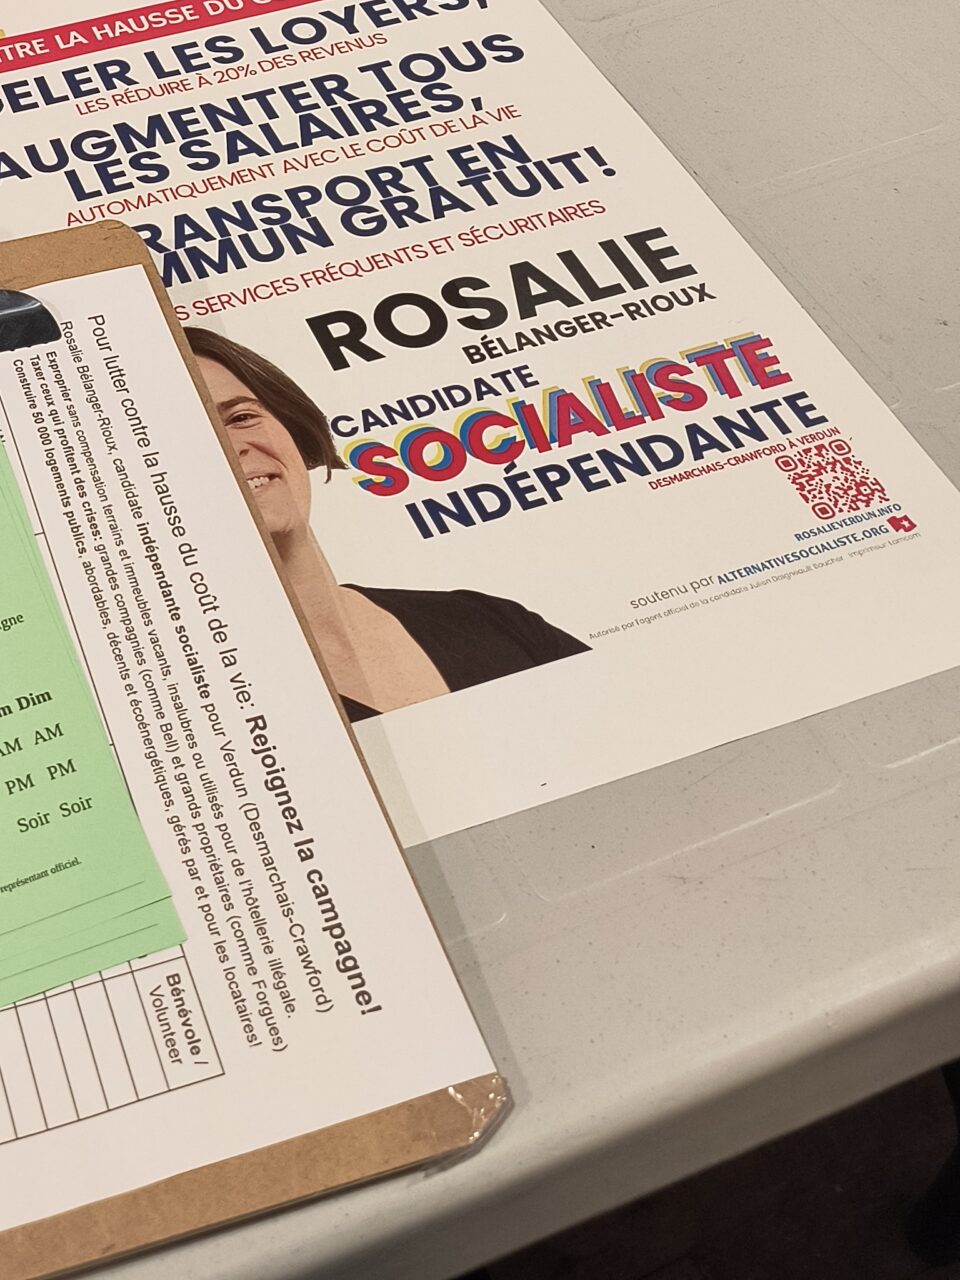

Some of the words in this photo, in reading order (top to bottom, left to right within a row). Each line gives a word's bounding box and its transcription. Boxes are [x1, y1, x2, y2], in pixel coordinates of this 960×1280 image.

[55, 31, 88, 49] LA
[92, 5, 199, 40] HAUSSE
[144, 36, 244, 79] LES
[76, 98, 109, 115] LES
[112, 78, 194, 106] RÉDUIRE
[199, 76, 212, 88] À
[213, 64, 257, 83] 20%
[257, 54, 297, 72] DES
[298, 33, 387, 62] REVENUS
[358, 34, 524, 92] TOUS
[64, 151, 170, 202] LES
[179, 82, 483, 171] SALAIRES,
[67, 162, 274, 226] AUTOMATIQUEMENT
[283, 149, 340, 174] AVEC
[345, 144, 366, 159] LE
[366, 126, 427, 152] COÛT
[429, 120, 459, 138] DE
[460, 113, 488, 130] LA
[486, 104, 521, 122] VIE
[138, 154, 439, 254] RANSPORT
[447, 134, 531, 179] EN
[339, 146, 616, 237] GRATUIT!
[192, 277, 299, 315] SERVICES
[300, 242, 430, 291] FRÉQUENTS
[433, 234, 458, 256] ET
[458, 198, 606, 249] SÉCURITAIRES
[305, 226, 699, 371] ROSALIE
[462, 283, 717, 364] BÉLANGER-RIOUX
[88, 315, 112, 351] Pour
[103, 355, 129, 393] lutter
[330, 364, 540, 439] CANDIDATE
[121, 399, 150, 448] contre
[344, 332, 793, 497] SOCIALISTE
[142, 452, 159, 468] la
[405, 391, 828, 540] INDÉPENDANTE
[648, 442, 786, 490] DESMARCHAIS-CRAWFORD
[787, 437, 799, 449] À
[800, 426, 840, 446] VERDUN
[150, 472, 186, 537] hausse
[794, 503, 901, 542] ROSALIEVERDUN.INFO
[178, 543, 198, 566] du
[630, 582, 688, 609] soutenu
[689, 574, 714, 594] par
[717, 524, 889, 584] ALTERNATIVESOCIALISTE.ORG
[190, 572, 220, 614] coût
[208, 619, 228, 643] de
[219, 648, 237, 668] la
[16, 689, 53, 712] Dim
[230, 672, 254, 709] vie:
[246, 715, 304, 834] Rejoignez
[294, 838, 314, 862] la
[307, 869, 382, 1015] campagne!
[148, 985, 183, 1065] Volunteer
[166, 972, 201, 1057] Bénévole
